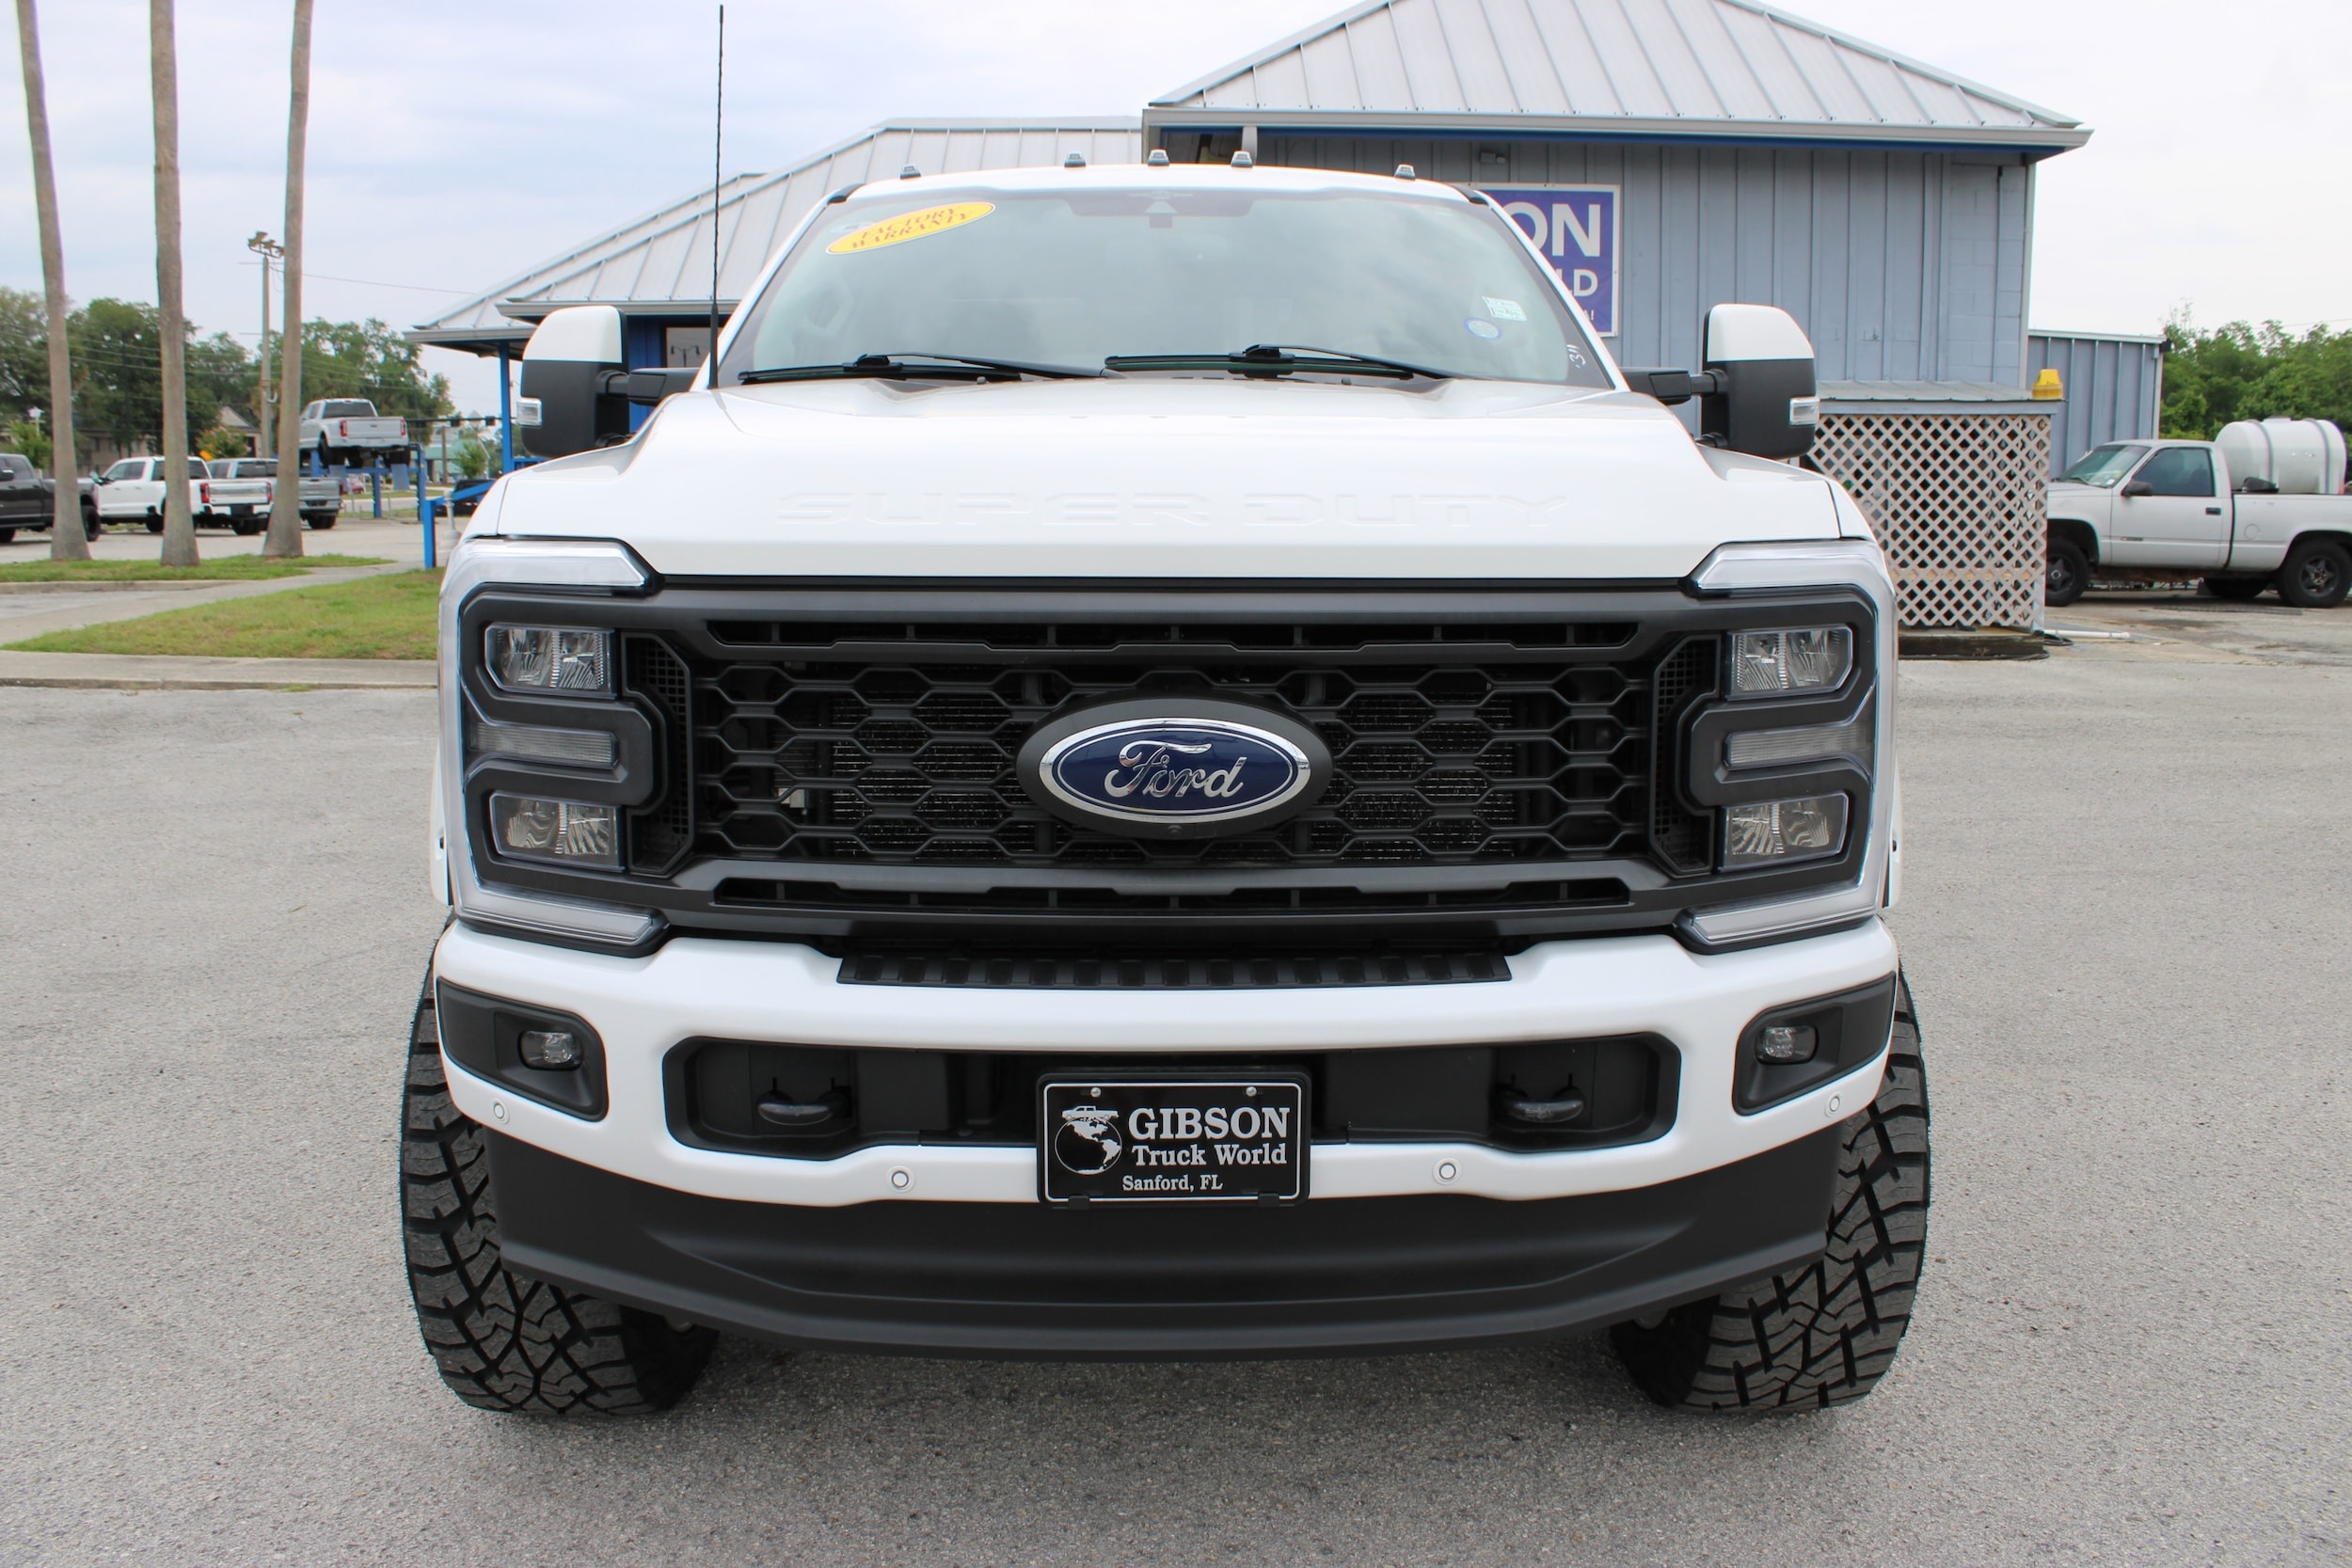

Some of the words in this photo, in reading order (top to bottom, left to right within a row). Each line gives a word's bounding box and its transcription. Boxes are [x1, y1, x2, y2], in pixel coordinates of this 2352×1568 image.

[775, 492, 1211, 526] SUPER
[1243, 493, 1569, 527] DUTY
[1104, 739, 1248, 799] Ford
[1128, 1107, 1290, 1140] GIBSON
[1131, 1144, 1207, 1166] Truck
[1214, 1143, 1287, 1165] World
[1121, 1175, 1195, 1193] Sanford,
[1200, 1175, 1224, 1191] FL
